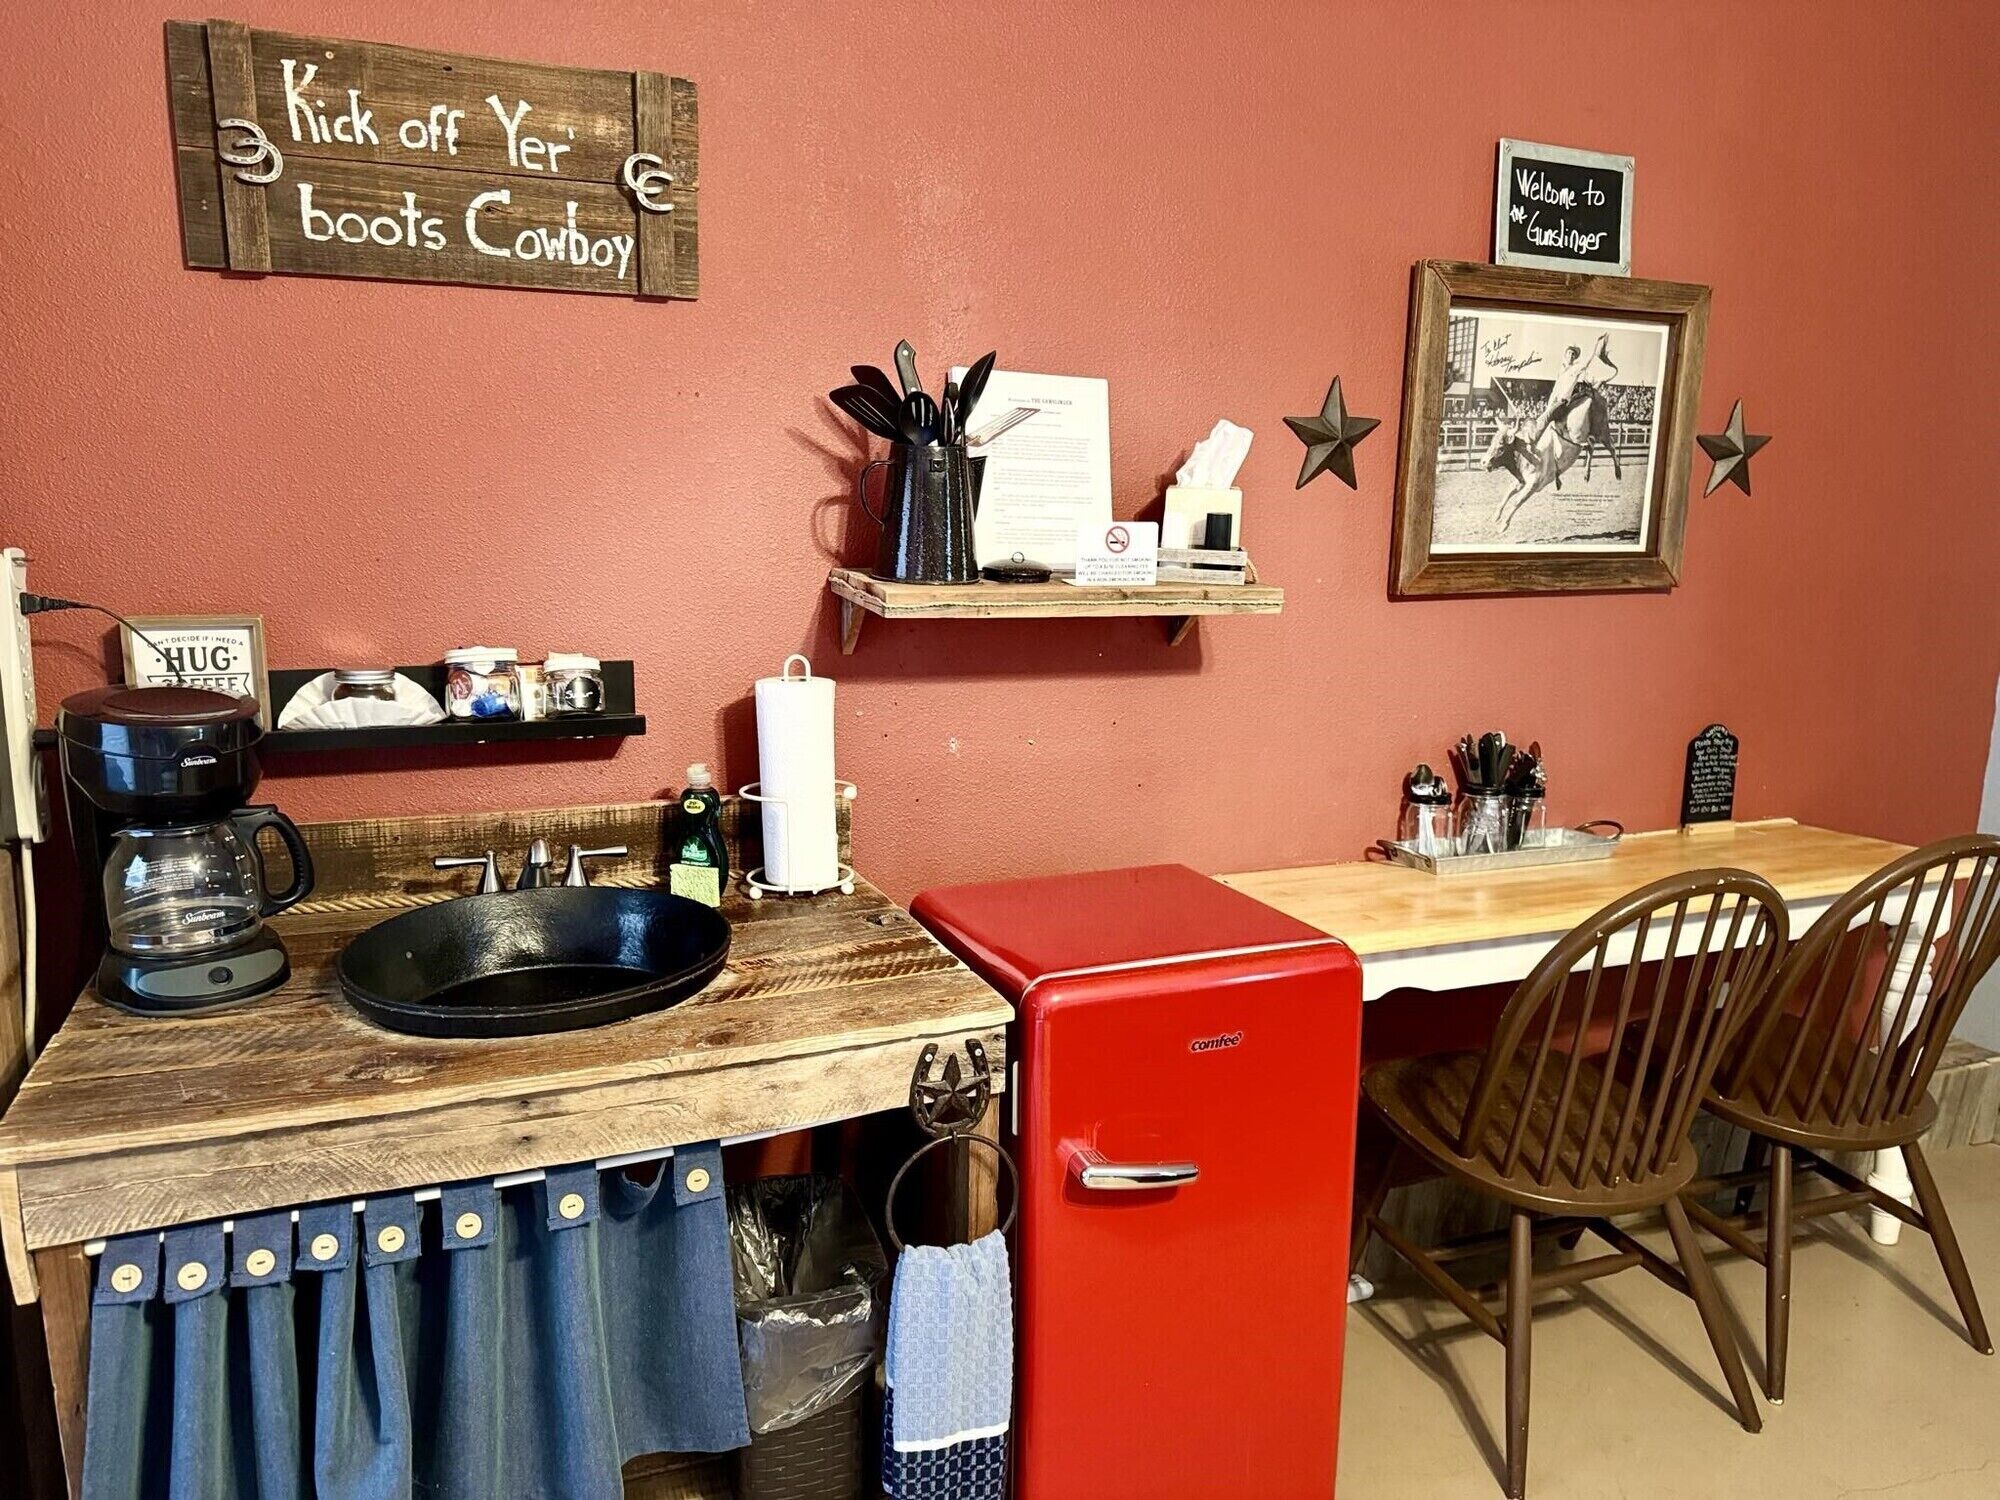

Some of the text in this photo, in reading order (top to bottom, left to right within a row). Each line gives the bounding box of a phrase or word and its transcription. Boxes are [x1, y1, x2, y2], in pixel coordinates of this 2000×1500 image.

[280, 58, 379, 146] Kick
[399, 105, 465, 156] off
[1515, 168, 1606, 210] Welcome to
[297, 183, 634, 280] boots Cowboy
[1509, 204, 1608, 254] the Gunslinger
[163, 645, 231, 673] HUG
[171, 635, 200, 643] DECIDE
[215, 636, 237, 645] NEED
[181, 908, 226, 925] Sunbeam
